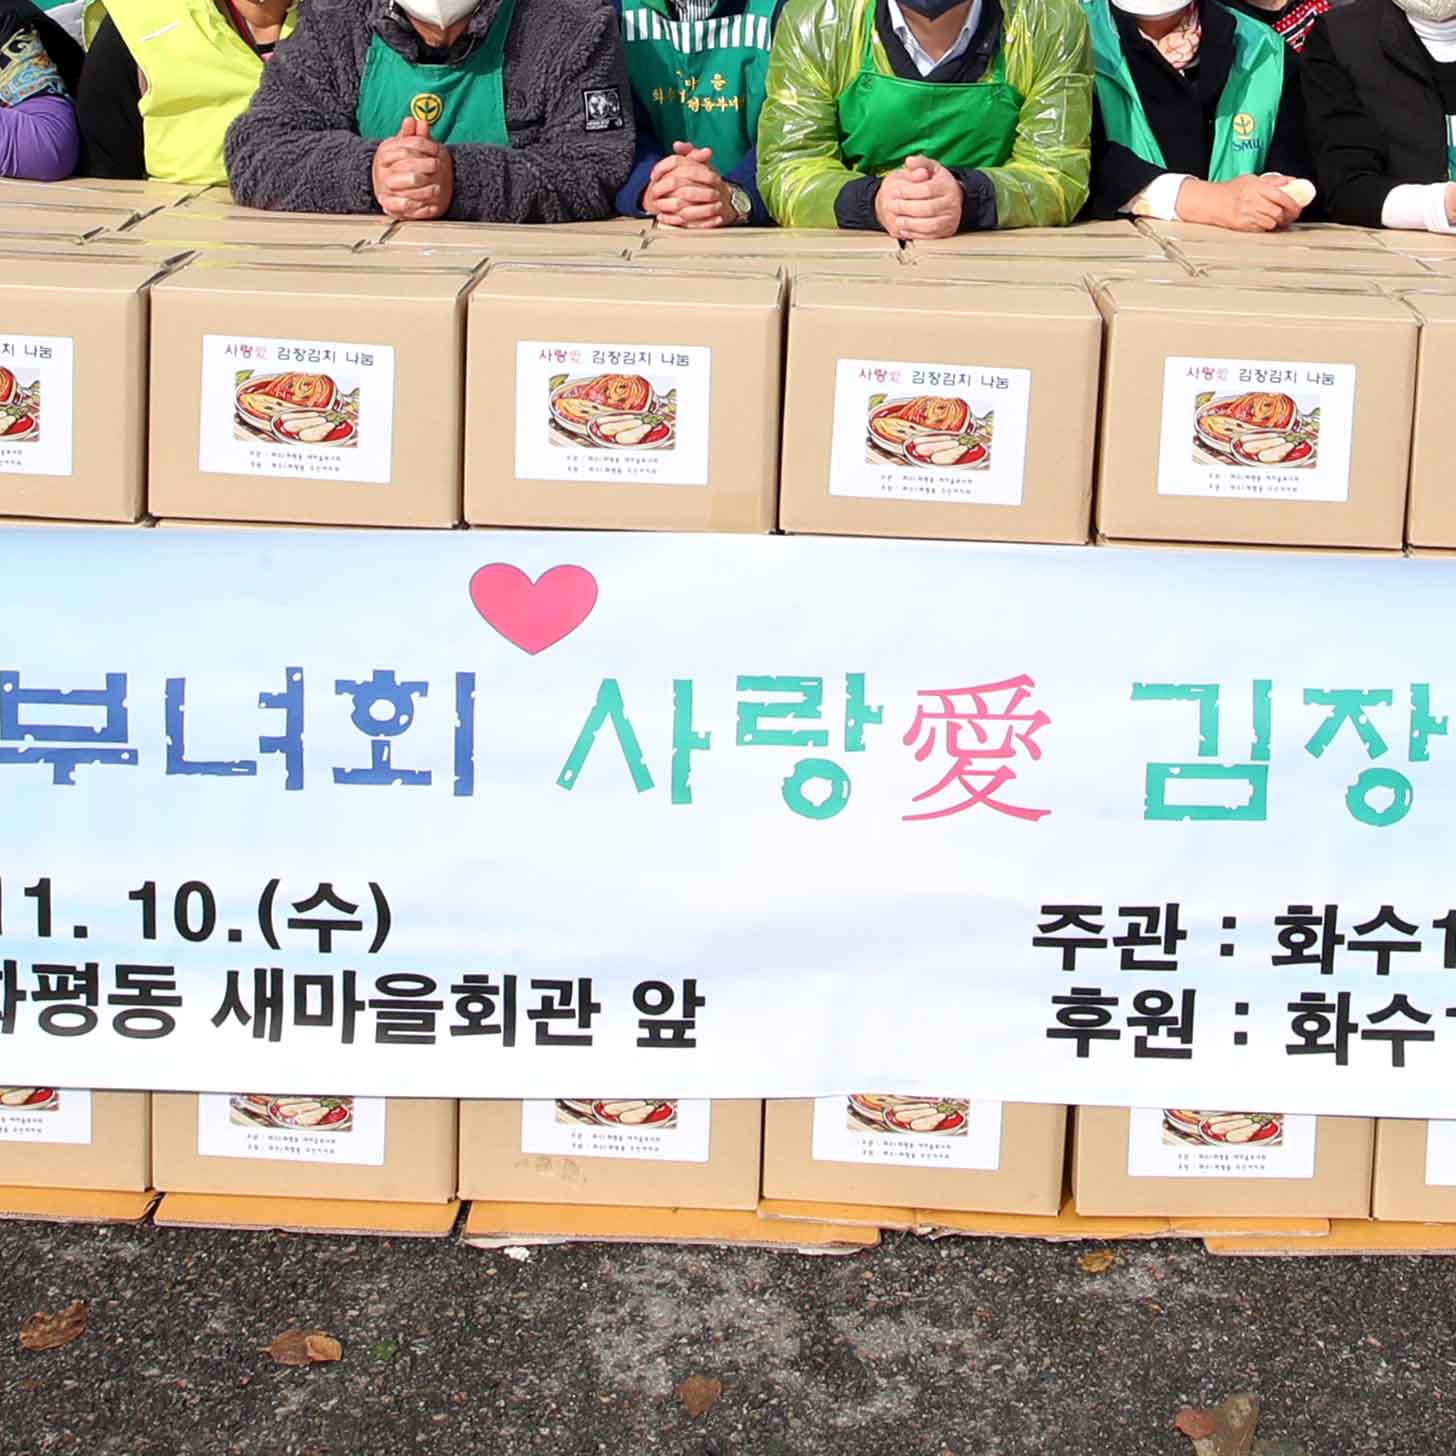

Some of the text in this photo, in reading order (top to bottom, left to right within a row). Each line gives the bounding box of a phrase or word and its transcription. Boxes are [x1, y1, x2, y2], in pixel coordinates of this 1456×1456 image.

[23, 343, 52, 359] 나눔
[277, 346, 336, 364] 김장김치
[345, 351, 374, 366] 나눔
[591, 349, 651, 366] 김장김치
[660, 352, 689, 367] 나눔
[911, 369, 971, 387] 김장김치
[980, 375, 1009, 389] 나눔
[1238, 367, 1297, 384] 김장김치
[1306, 371, 1335, 386] 나눔
[556, 672, 1052, 823] 사랑愛
[1131, 678, 1449, 828] 김장
[1032, 902, 1186, 972] 주관
[213, 968, 601, 1047] 새마을회관
[634, 980, 704, 1046] 앞
[1047, 988, 1195, 1058] 후원
